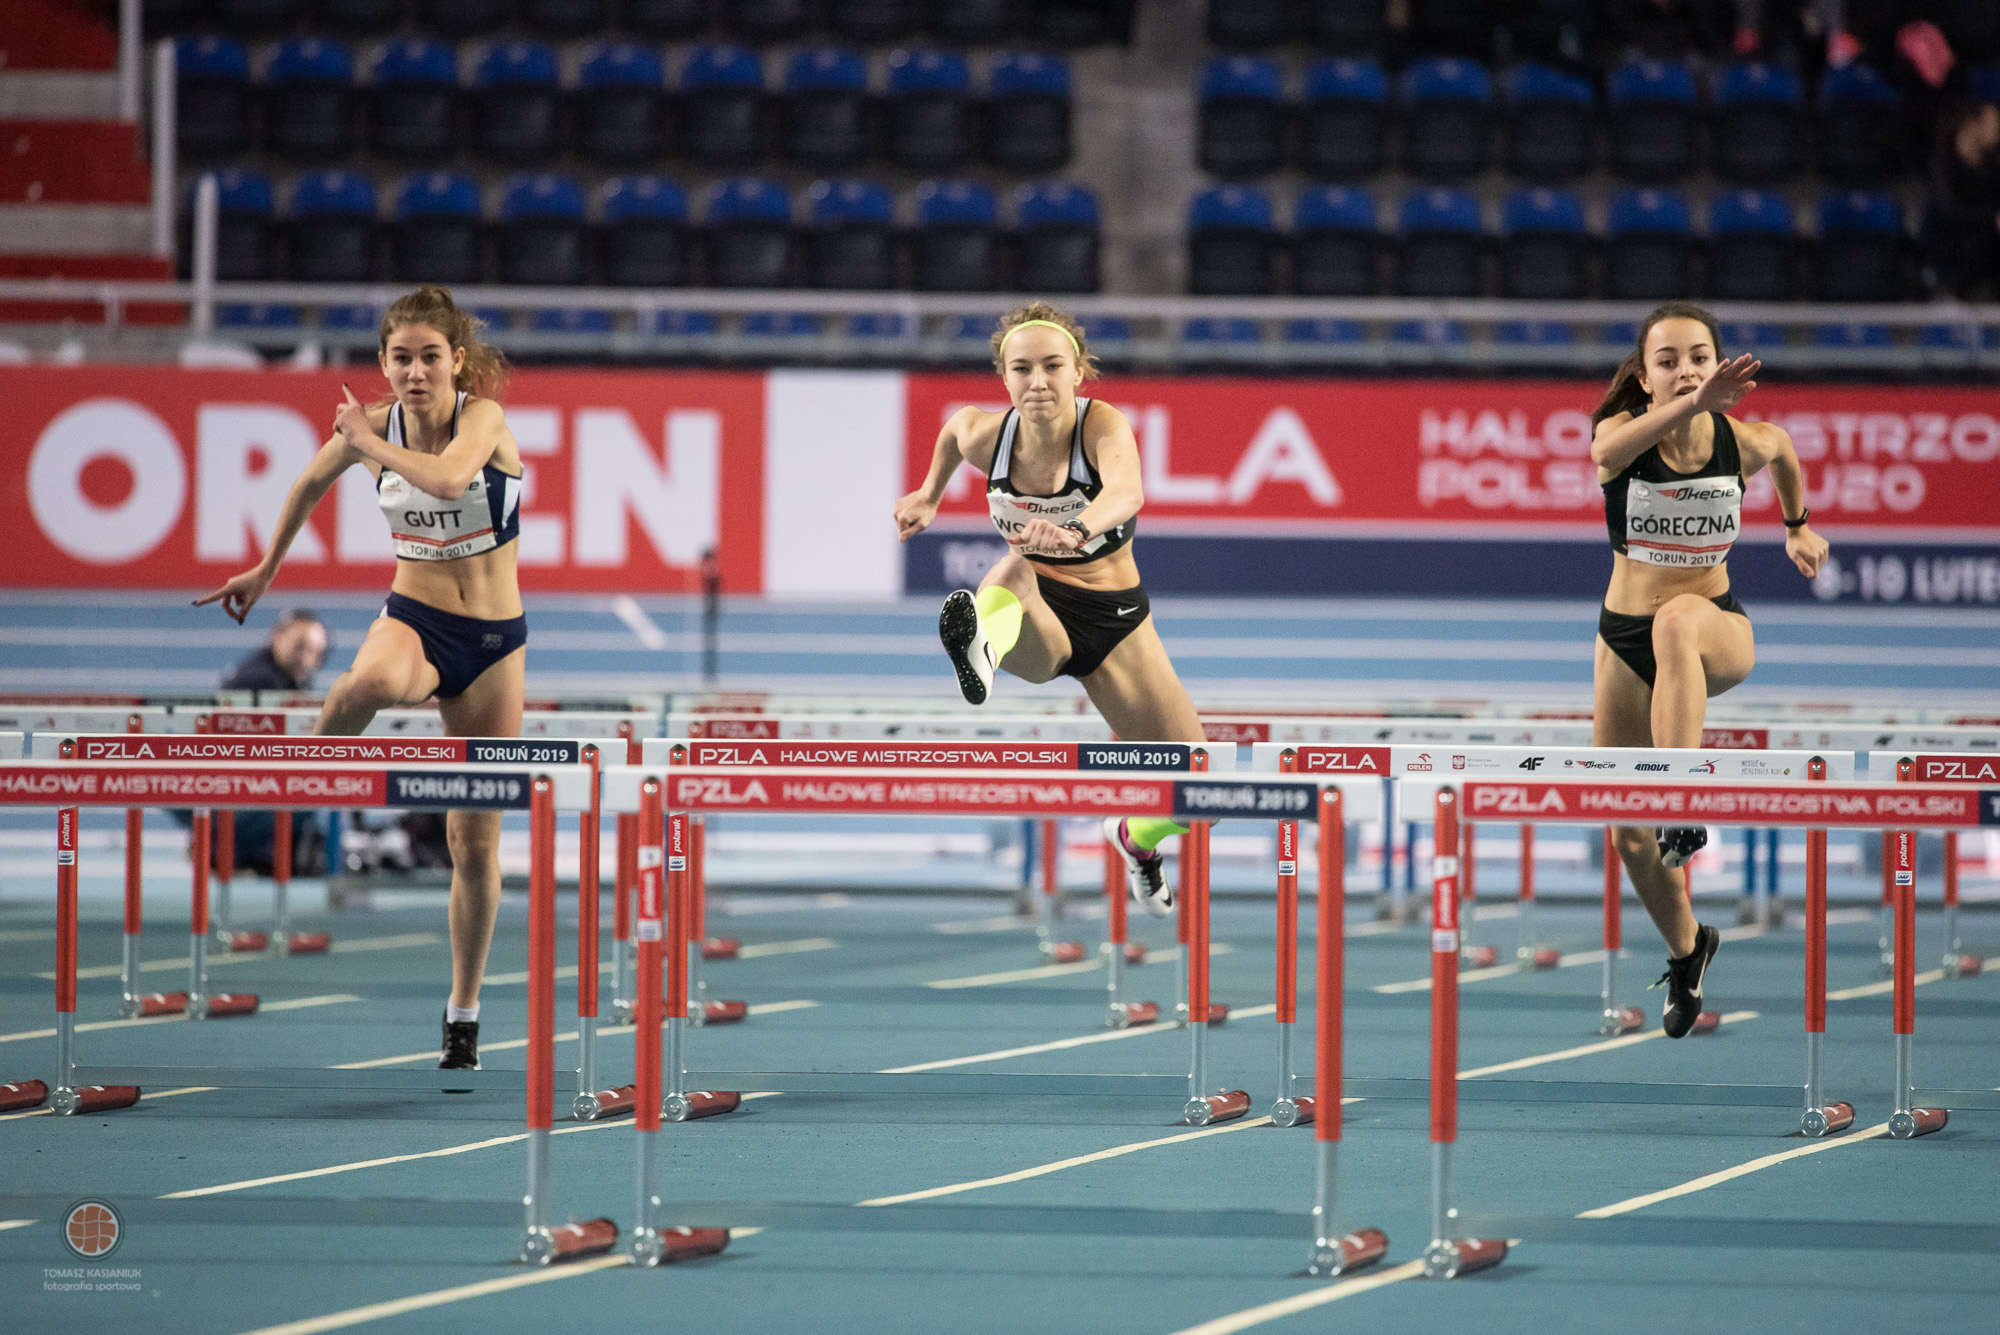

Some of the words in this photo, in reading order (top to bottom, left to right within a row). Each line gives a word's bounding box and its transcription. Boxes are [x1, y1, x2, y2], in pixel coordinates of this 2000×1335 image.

[404, 510, 462, 529] GUTT
[1631, 514, 1736, 536] GÓRECZNA
[447, 543, 472, 557] 2019
[1650, 551, 1687, 564] TORUŃ
[1691, 554, 1717, 565] 2019
[86, 743, 156, 759] PZLA
[168, 744, 246, 757] HALOWE
[250, 745, 386, 758] MISTRZOSTWA
[390, 746, 455, 759] POLSKI
[475, 746, 528, 761] TORUŃ
[532, 749, 569, 762] 2019
[700, 749, 768, 765] PZLA
[780, 750, 858, 763] HALOWE
[862, 750, 998, 763] MISTRZOSTWA
[1002, 750, 1067, 763] POLSKI
[1087, 749, 1139, 764] TORUŃ
[1144, 752, 1181, 765] 2019
[1308, 753, 1377, 770] PZLA
[1634, 763, 1671, 772] 4MOVE
[1926, 762, 1997, 779] PZLA
[103, 775, 281, 795] MISTRZOSTWA
[286, 776, 373, 797] POLSKI
[397, 776, 467, 799] TORUŃ
[471, 779, 521, 800] 2019
[677, 778, 770, 804] PZLA
[782, 782, 886, 803] HALOWE
[889, 783, 1069, 805] MISTRZOSTWA
[1072, 785, 1161, 806] POLSKI
[1183, 783, 1254, 808] TORUŃ
[1256, 788, 1309, 810] 2019
[1472, 786, 1567, 812] PZLA
[1580, 791, 1685, 812] HALOWE
[1689, 790, 1872, 815] MISTRZOSTWA
[1876, 793, 1967, 816] POLSKI
[62, 813, 72, 847] polanik
[673, 819, 683, 853] polanik
[1283, 823, 1293, 857] polanik
[1899, 833, 1909, 867] polanik
